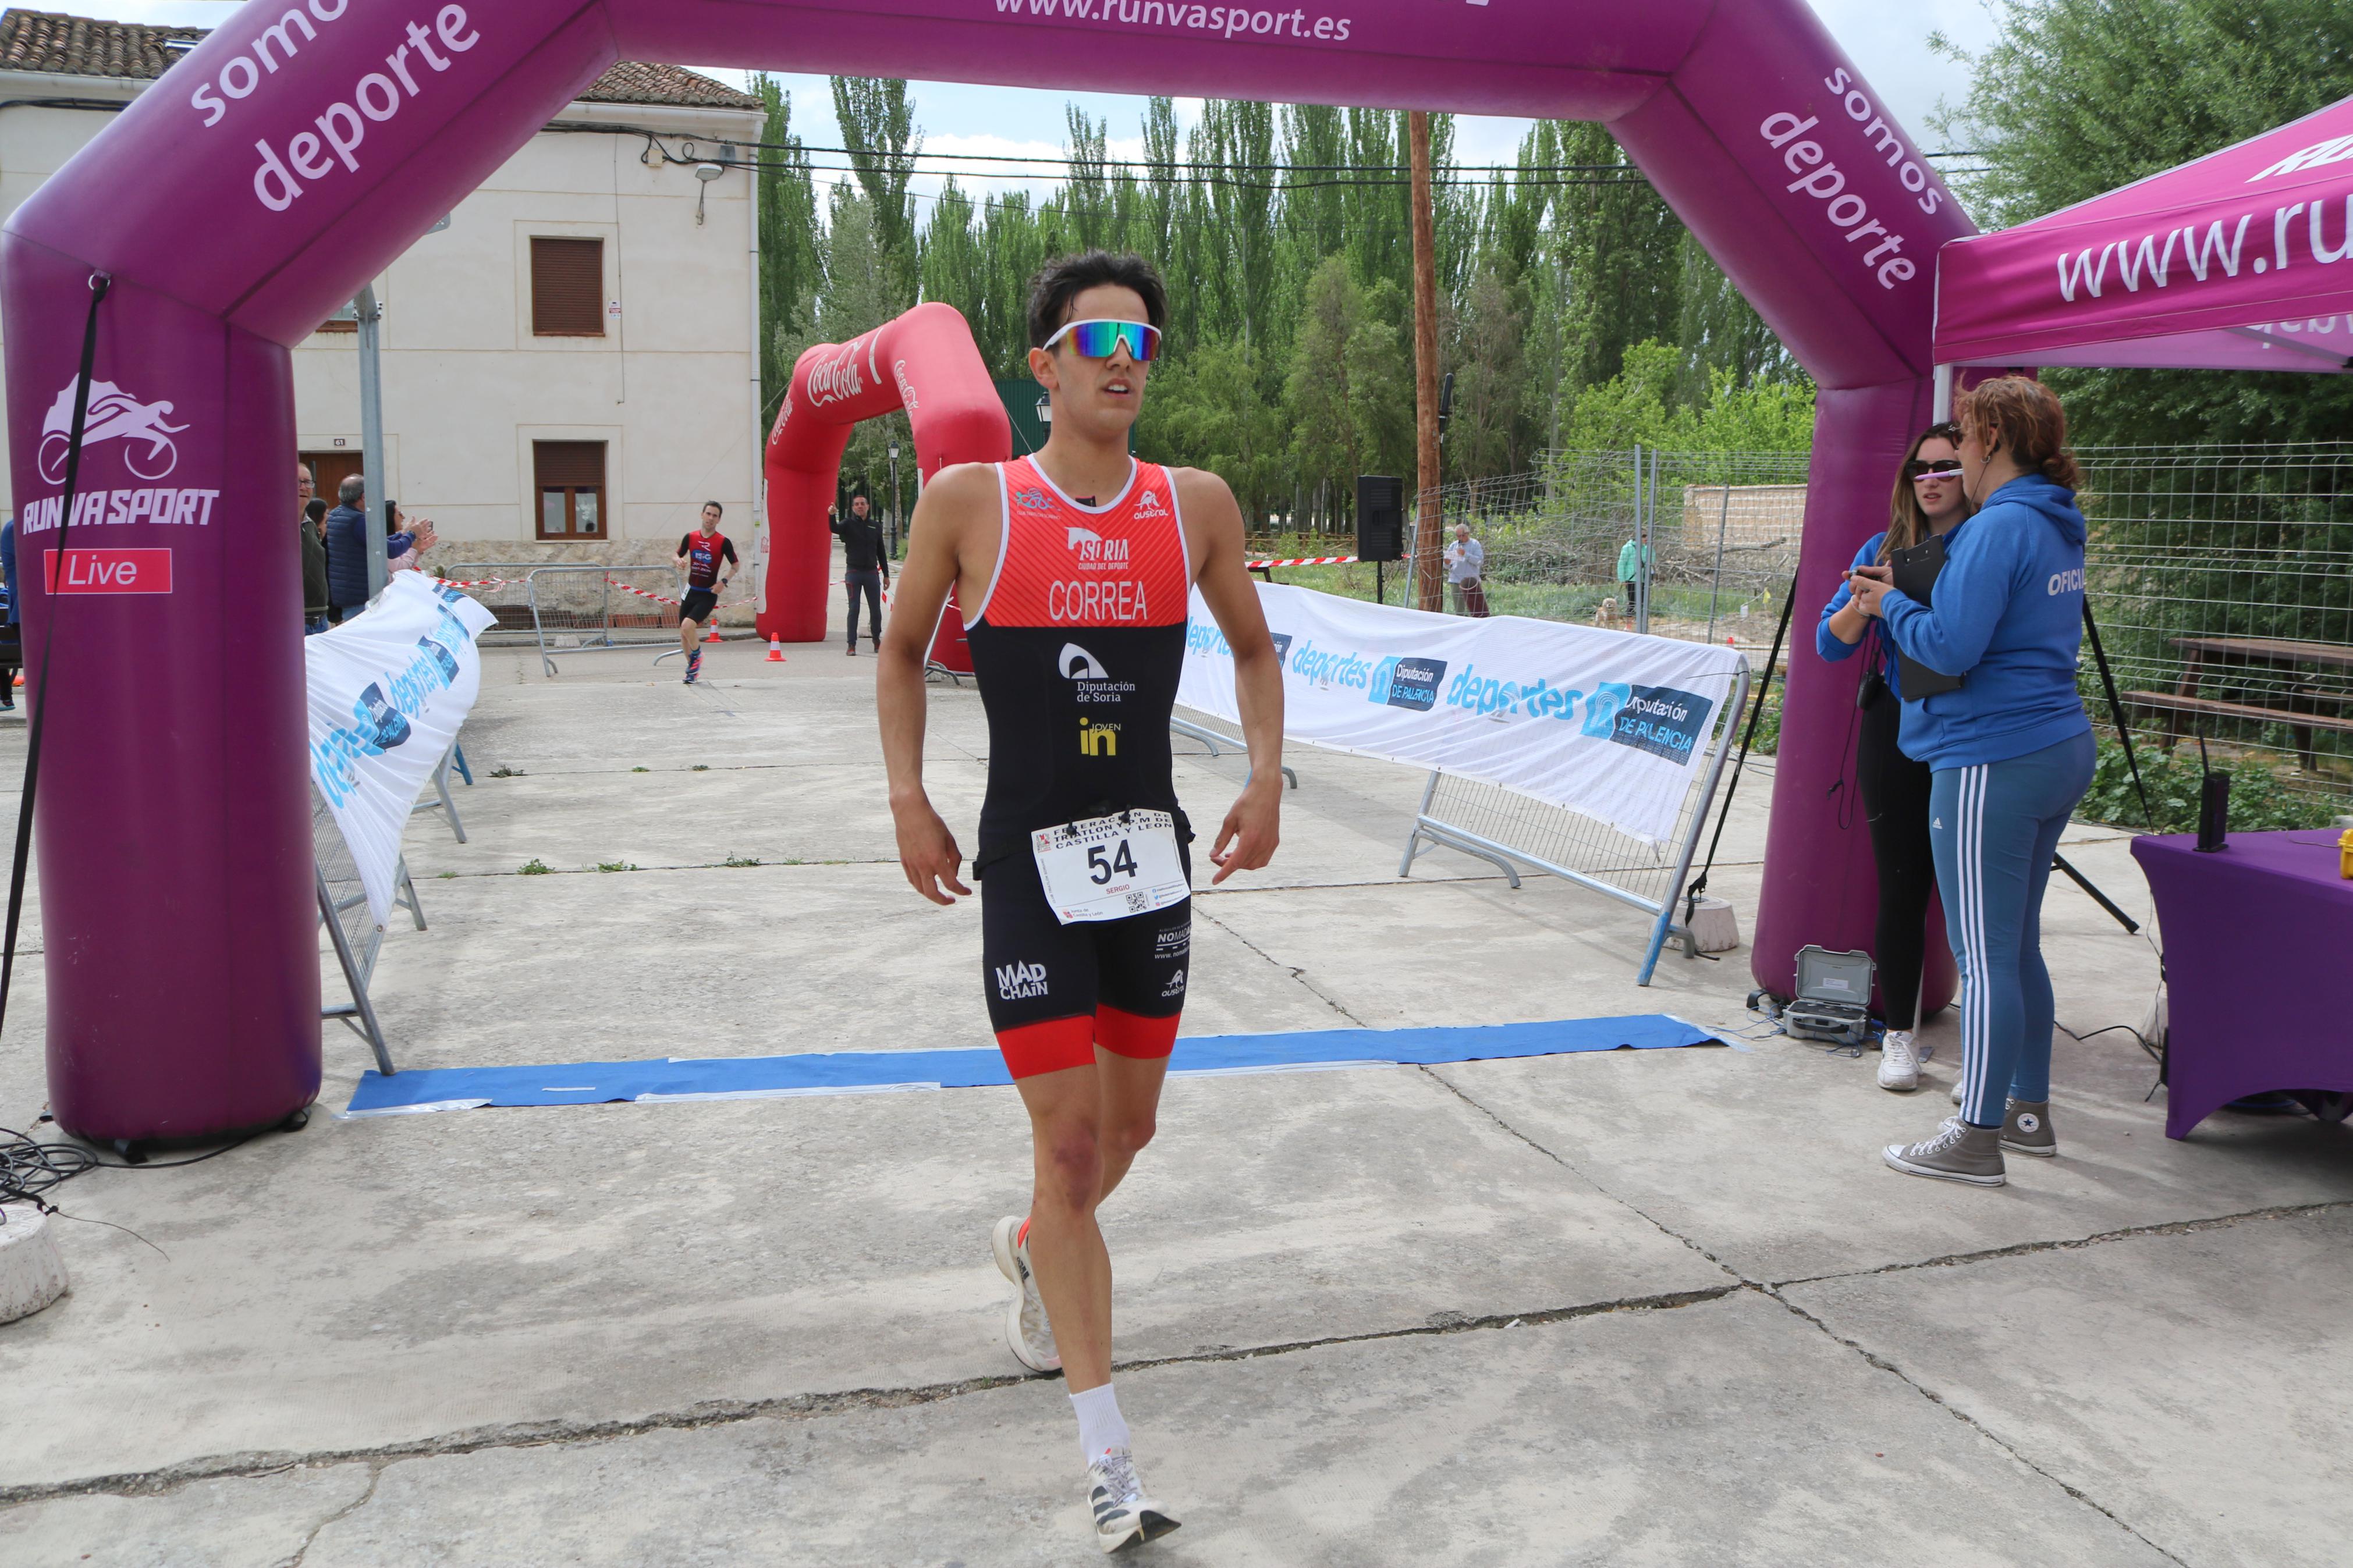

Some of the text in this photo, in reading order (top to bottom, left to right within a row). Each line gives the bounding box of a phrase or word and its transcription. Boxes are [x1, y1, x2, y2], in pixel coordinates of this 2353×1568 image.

[254, 4, 480, 212] deporte
[1824, 67, 1943, 215] somos
[1760, 112, 1915, 290] deporte
[23, 488, 220, 535] RUNVASPORT
[68, 554, 137, 585] Live
[1078, 562, 1095, 570] CIUDAD
[1049, 580, 1148, 621] CORREA
[1293, 639, 1372, 689] deportes
[1397, 664, 1434, 682] Diputación
[1077, 681, 1135, 694] Diputación
[1077, 692, 1121, 702] de Soria
[1392, 684, 1435, 703] DE PALENCIA
[1446, 664, 1583, 720] deportes
[1080, 717, 1116, 756] in
[1092, 724, 1121, 733] JOVEN
[1619, 717, 1692, 753] DE PALENCIA
[1056, 831, 1119, 849] CASTILLA
[1138, 823, 1172, 831] LEON
[1087, 838, 1138, 885] 54
[1106, 884, 1130, 895] SERGIO
[995, 959, 1046, 989] MAD
